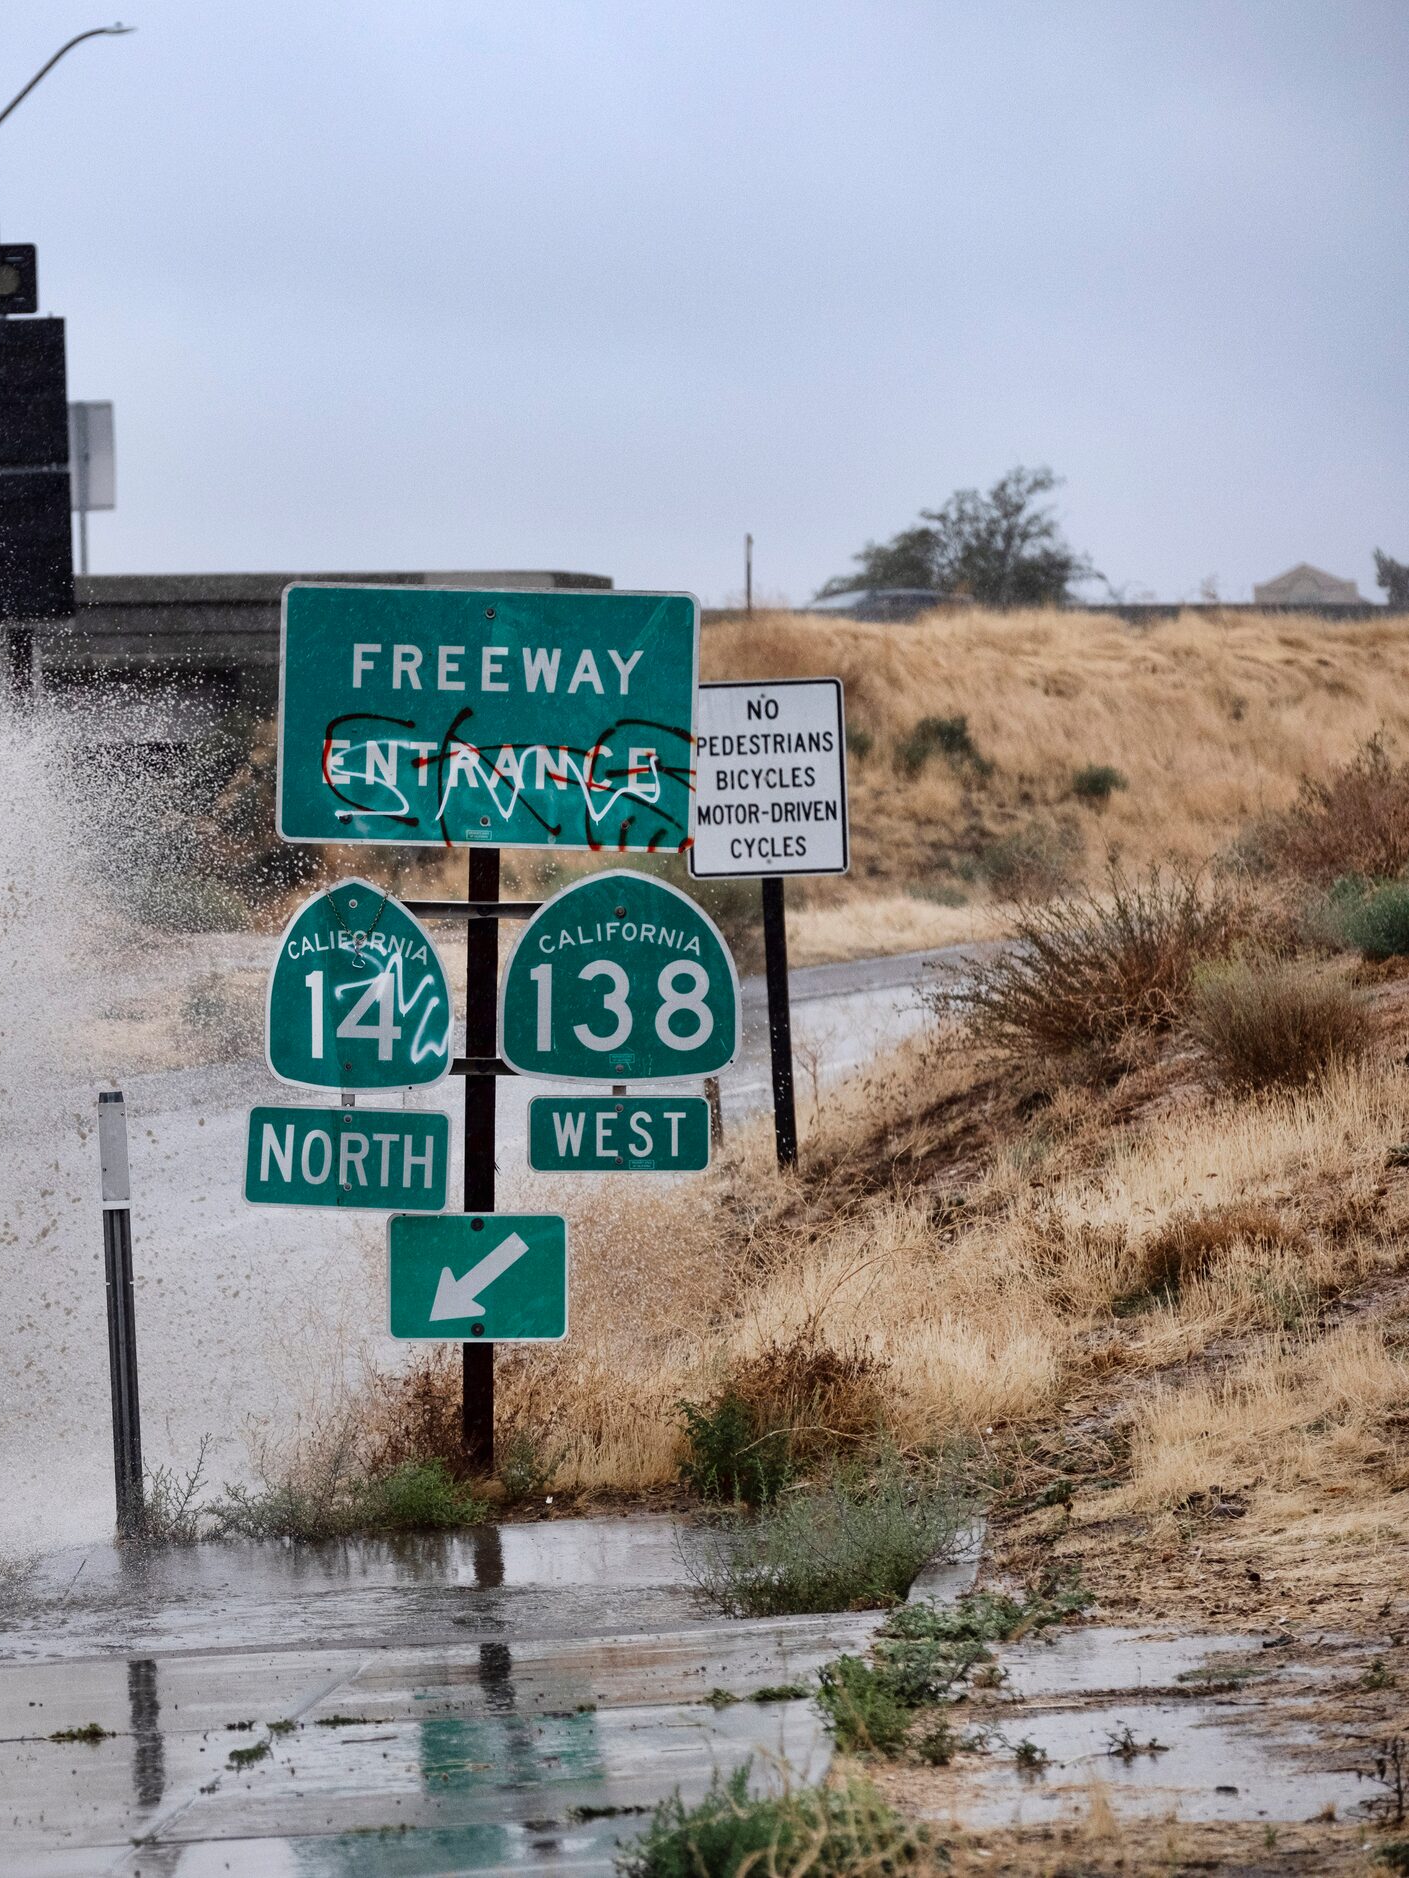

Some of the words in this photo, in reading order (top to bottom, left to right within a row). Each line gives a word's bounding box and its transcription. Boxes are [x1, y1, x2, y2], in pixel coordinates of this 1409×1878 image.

[352, 643, 644, 695] FREEWAY
[747, 698, 780, 720] NO
[697, 731, 834, 757] PEDESTRIANS
[322, 738, 657, 793] ENTRANCE
[716, 766, 816, 791] BICYCLES
[697, 800, 838, 826] MOTOR-DRIVEN
[730, 836, 807, 859] CYCLES
[287, 929, 428, 966] CALIFORNIA
[539, 922, 701, 957] CALIFORNIA
[305, 970, 402, 1061] 14
[530, 959, 714, 1052] 138
[552, 1111, 687, 1158] WEST
[259, 1122, 434, 1189] NORTH
